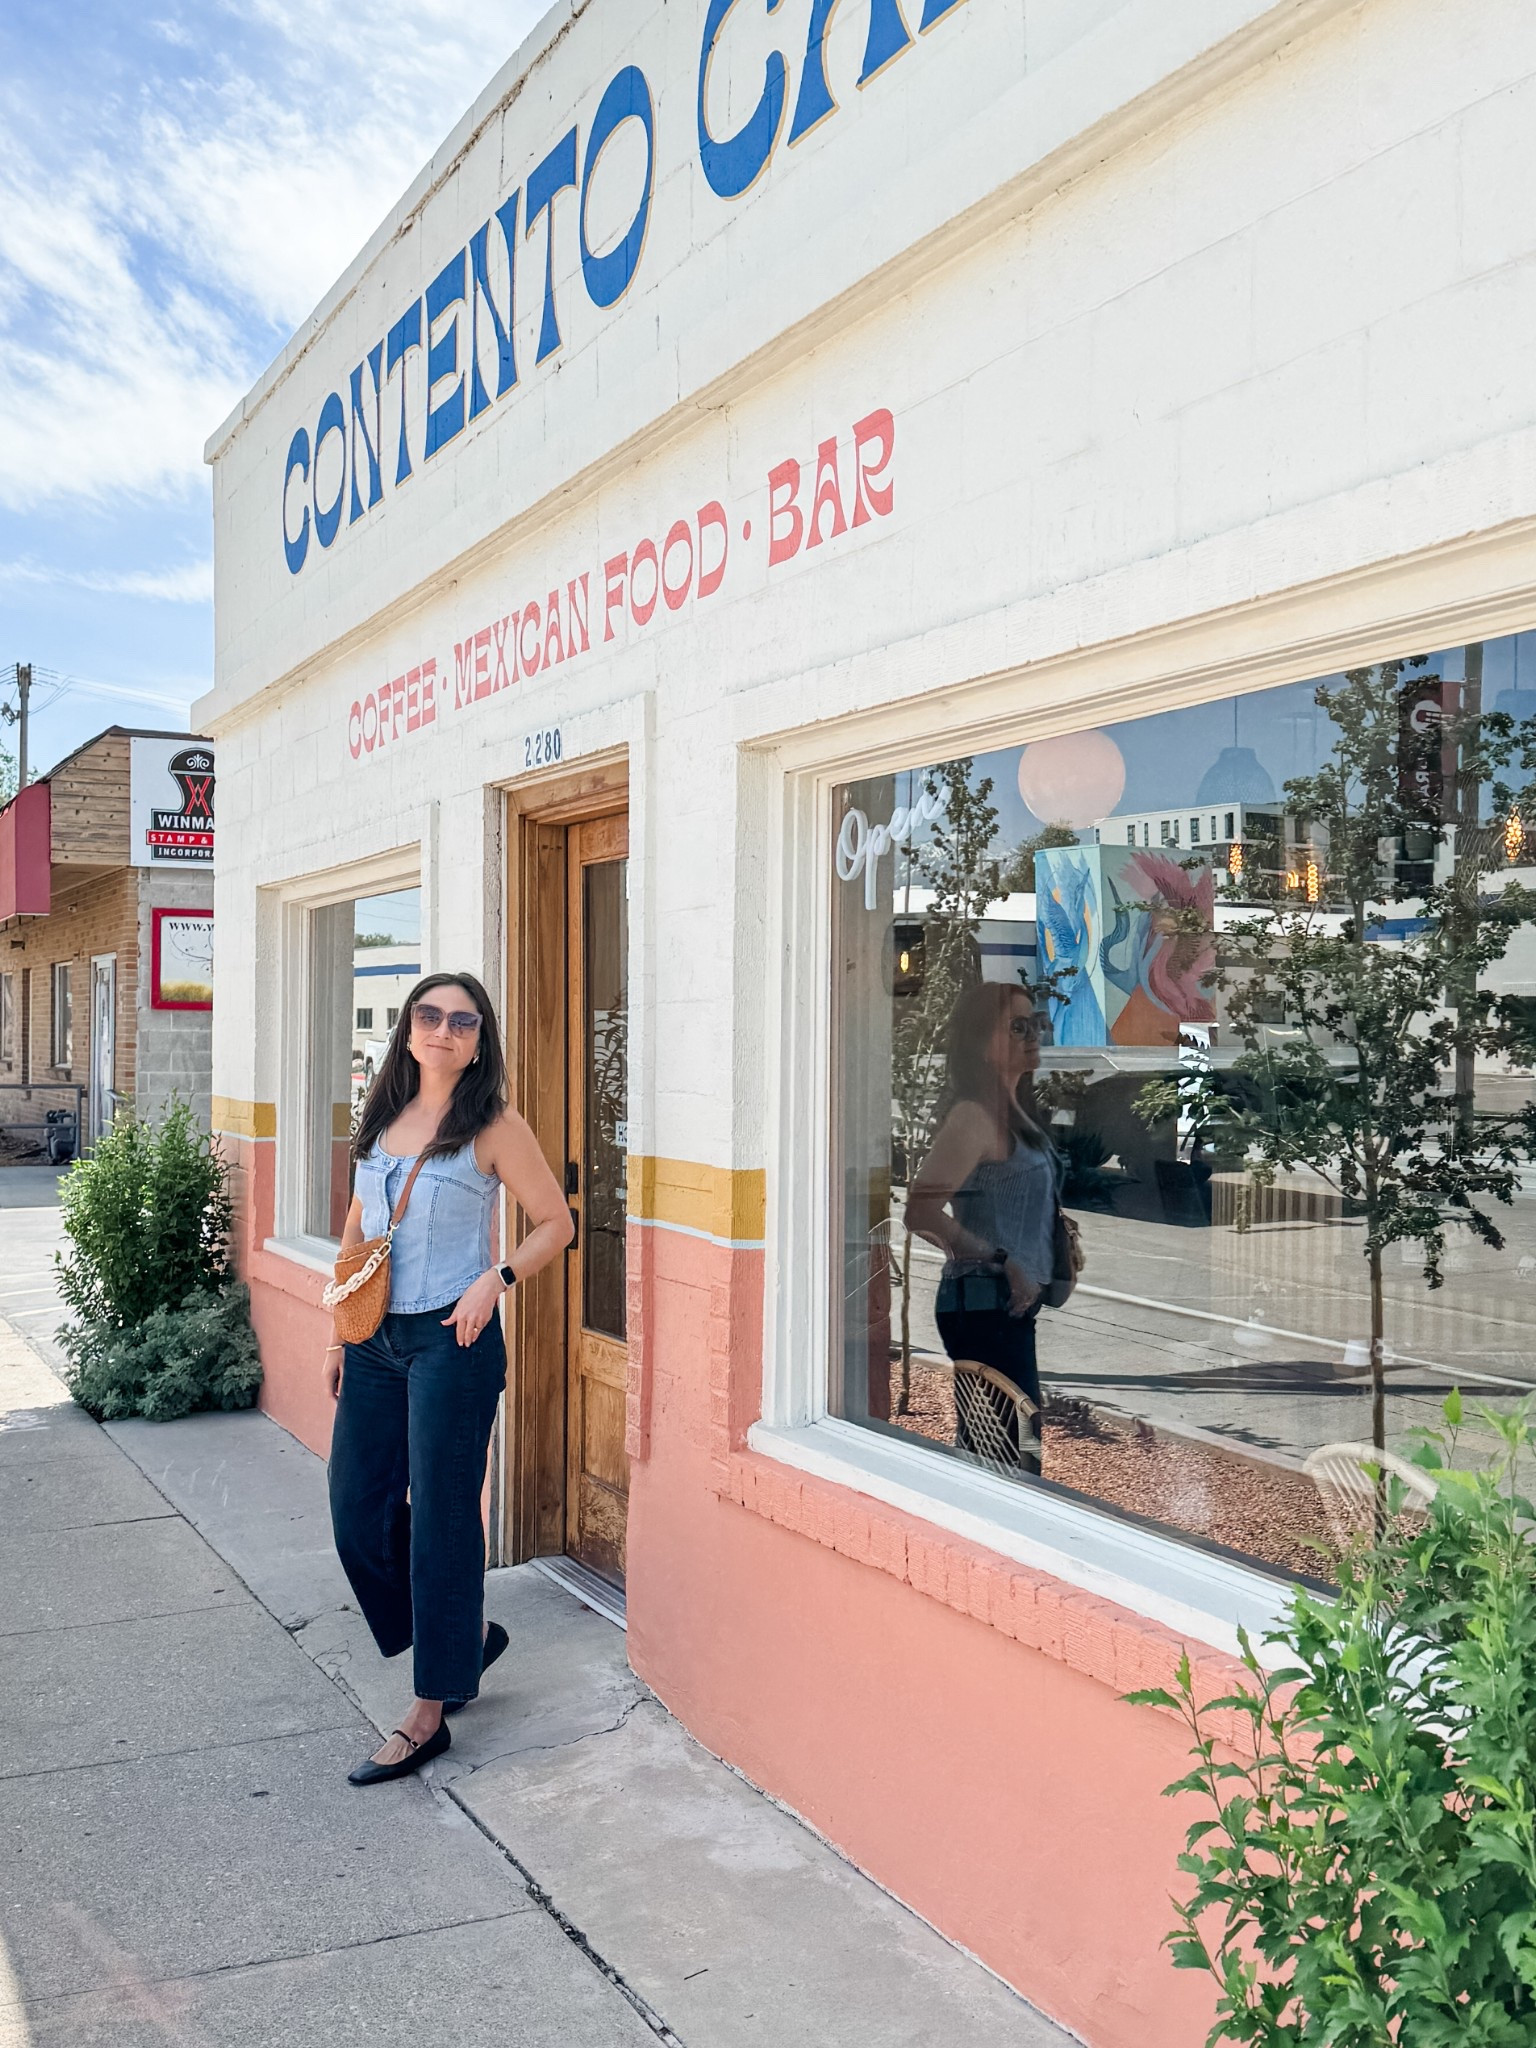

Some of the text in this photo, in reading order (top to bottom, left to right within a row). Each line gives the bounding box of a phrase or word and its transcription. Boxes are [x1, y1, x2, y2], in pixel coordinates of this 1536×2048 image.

[283, 65, 656, 576] CONTENTO
[349, 408, 895, 760] COFFEE MEXICAN FOOD BAR
[525, 728, 561, 767] 2280
[150, 834, 208, 844] STAMP &
[158, 848, 214, 857] INCORPOR
[836, 786, 953, 911] Open
